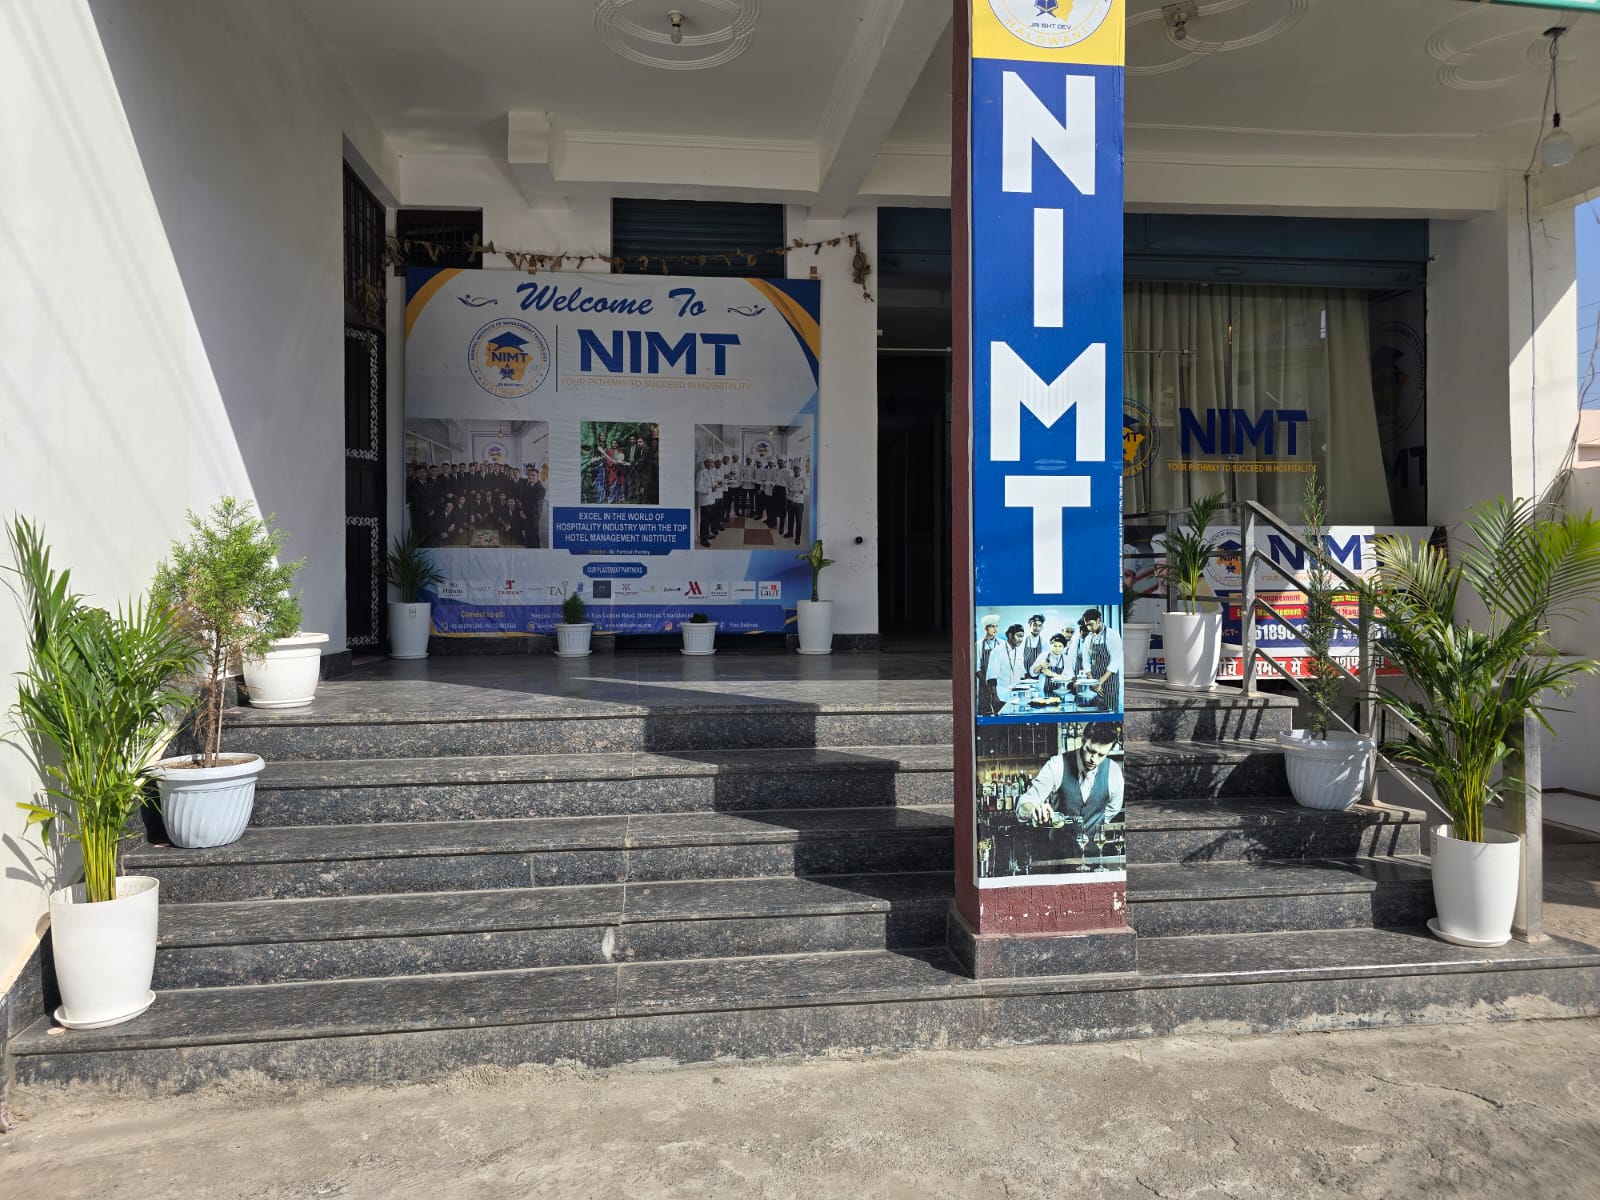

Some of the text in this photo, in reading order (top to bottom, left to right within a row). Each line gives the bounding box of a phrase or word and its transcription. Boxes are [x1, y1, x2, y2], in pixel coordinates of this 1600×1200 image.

[1006, 18, 1088, 46] HALDWANI
[516, 281, 706, 318] Welcome To
[990, 70, 1106, 595] NIMT
[491, 351, 529, 363] NIMT
[577, 329, 741, 376] NIMT
[561, 378, 752, 390] YOUR PATHWAY TO SUCCEED IN HOSPITALITY
[1178, 407, 1309, 456] NIMT
[1167, 463, 1317, 474] YOUR PATHWAY TO SUCCEED IN HOSPITALITY
[579, 512, 665, 521] EXCEL IN THE WORLD OF
[556, 523, 687, 532] HOSPITALITY INDUSTRY WITH THE TOP
[565, 534, 677, 543] HOTEL MANAGEMENT INSTITUTE
